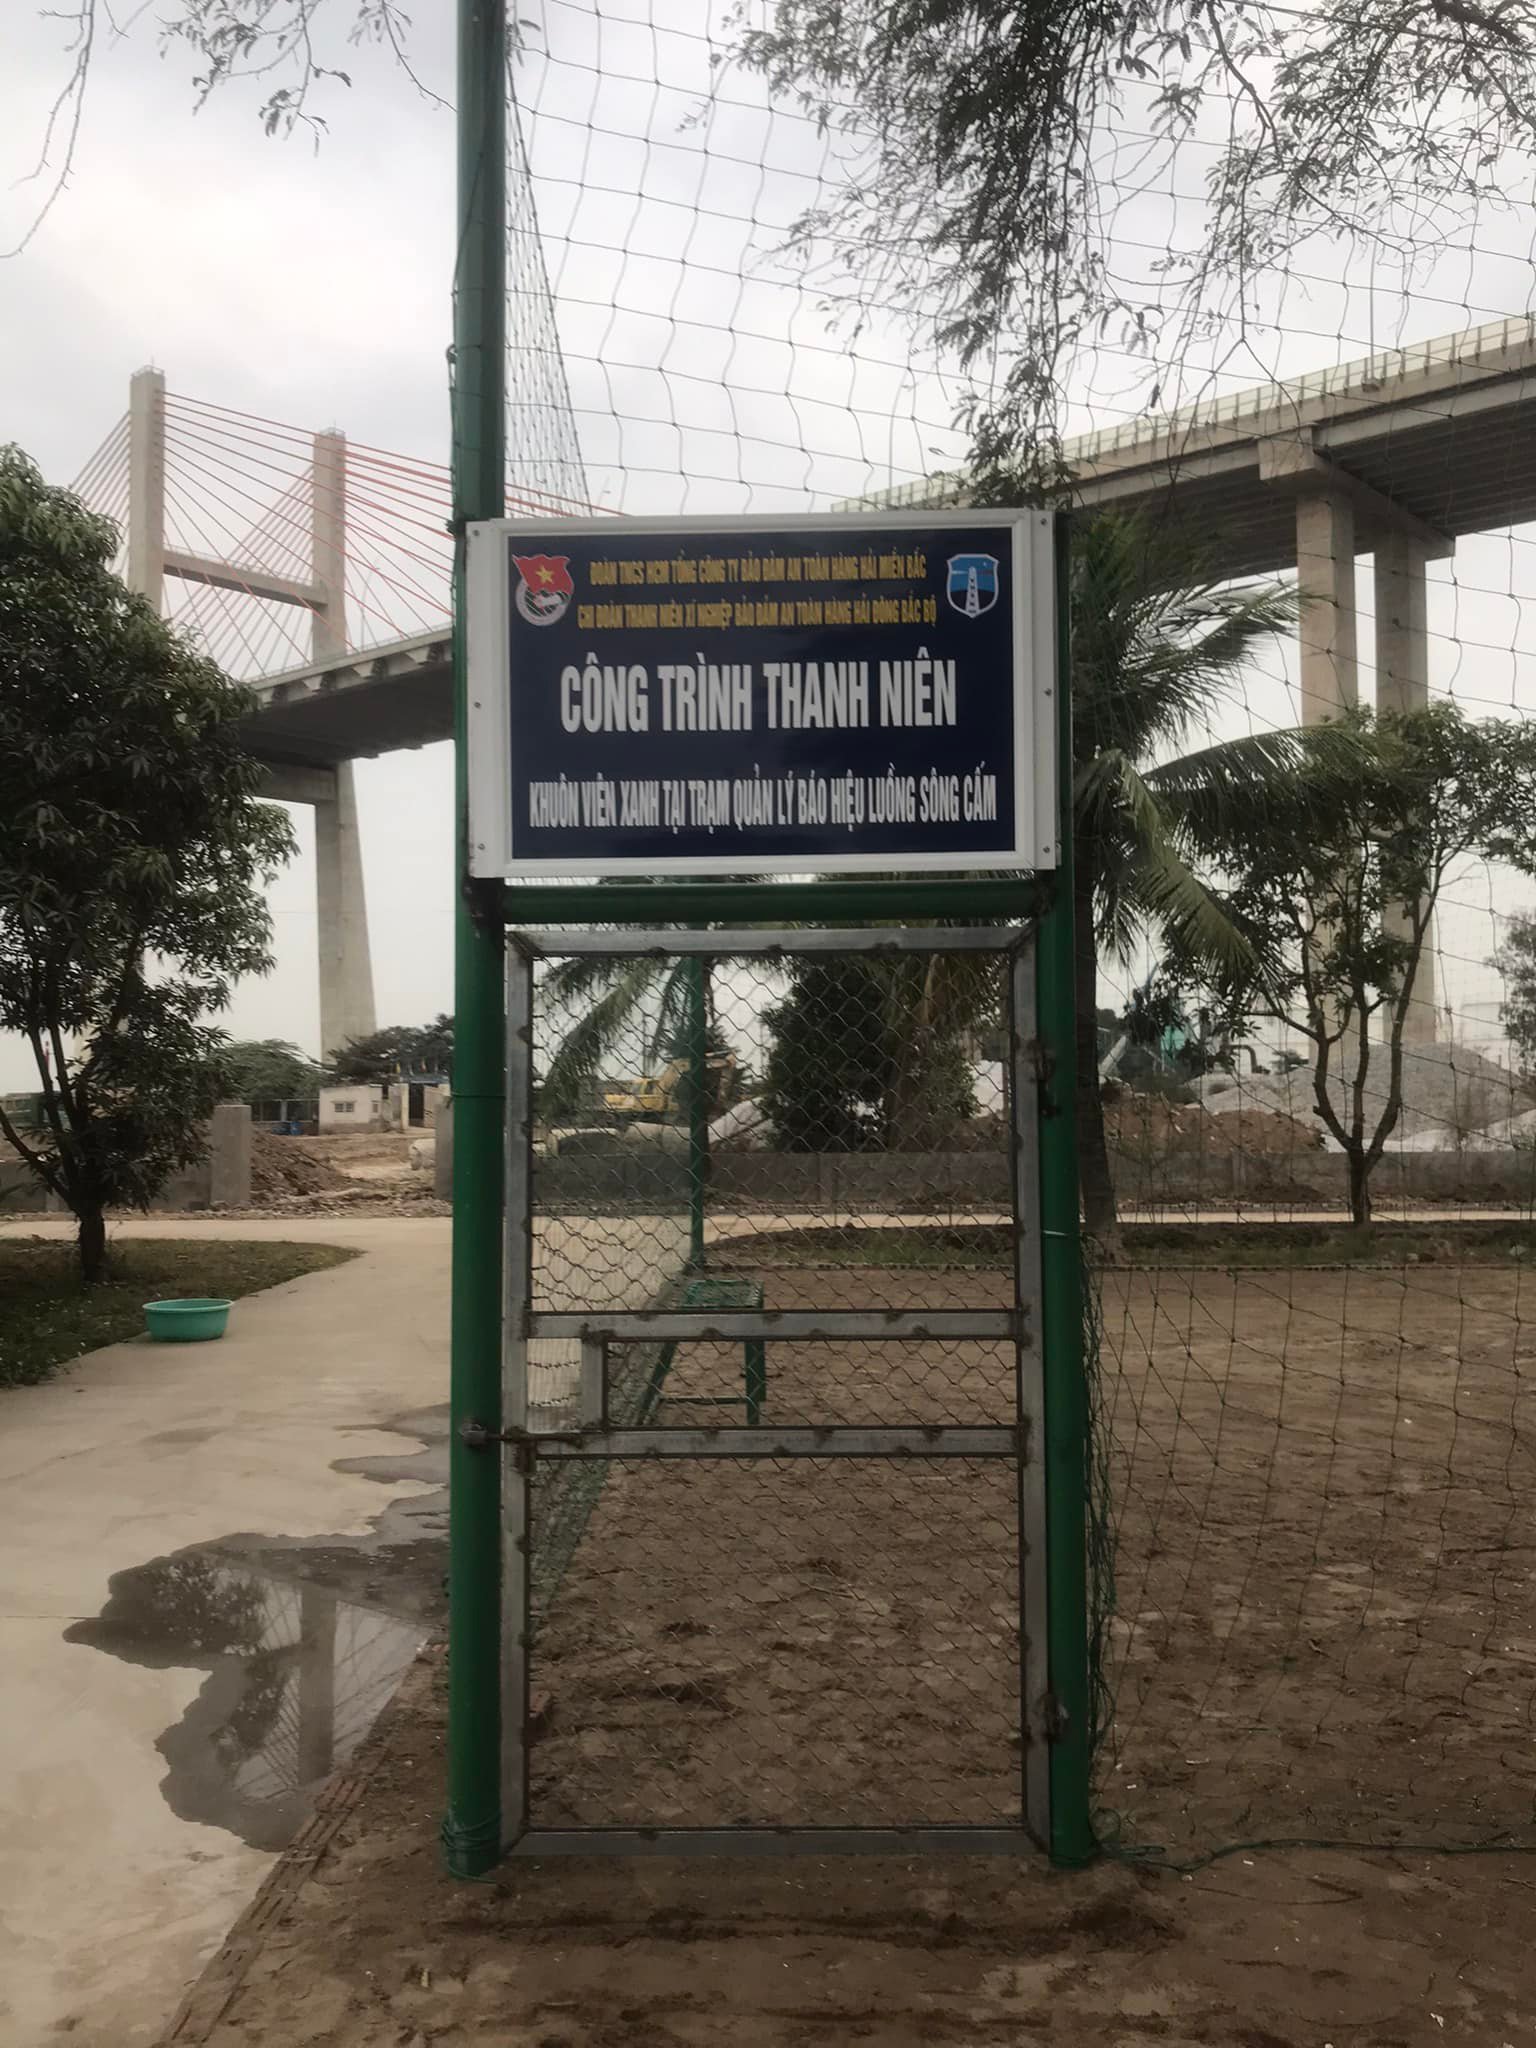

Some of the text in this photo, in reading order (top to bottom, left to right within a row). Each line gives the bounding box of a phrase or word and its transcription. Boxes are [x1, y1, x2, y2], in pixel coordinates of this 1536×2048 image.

[560, 646, 957, 733] CÔNG TRÌNH THANH NIÊN
[529, 772, 579, 828] KHUÔN
[581, 772, 617, 827] VIÊN
[619, 780, 660, 827] XANH
[661, 780, 686, 834] TẠI
[687, 779, 730, 834] TRẠM
[732, 763, 773, 832] QUẢN
[777, 770, 794, 825] LÝ
[830, 768, 865, 832] HIỆU
[868, 762, 917, 824] LUỒNG
[919, 766, 960, 823] SÔNG
[963, 760, 997, 822] CẤM
